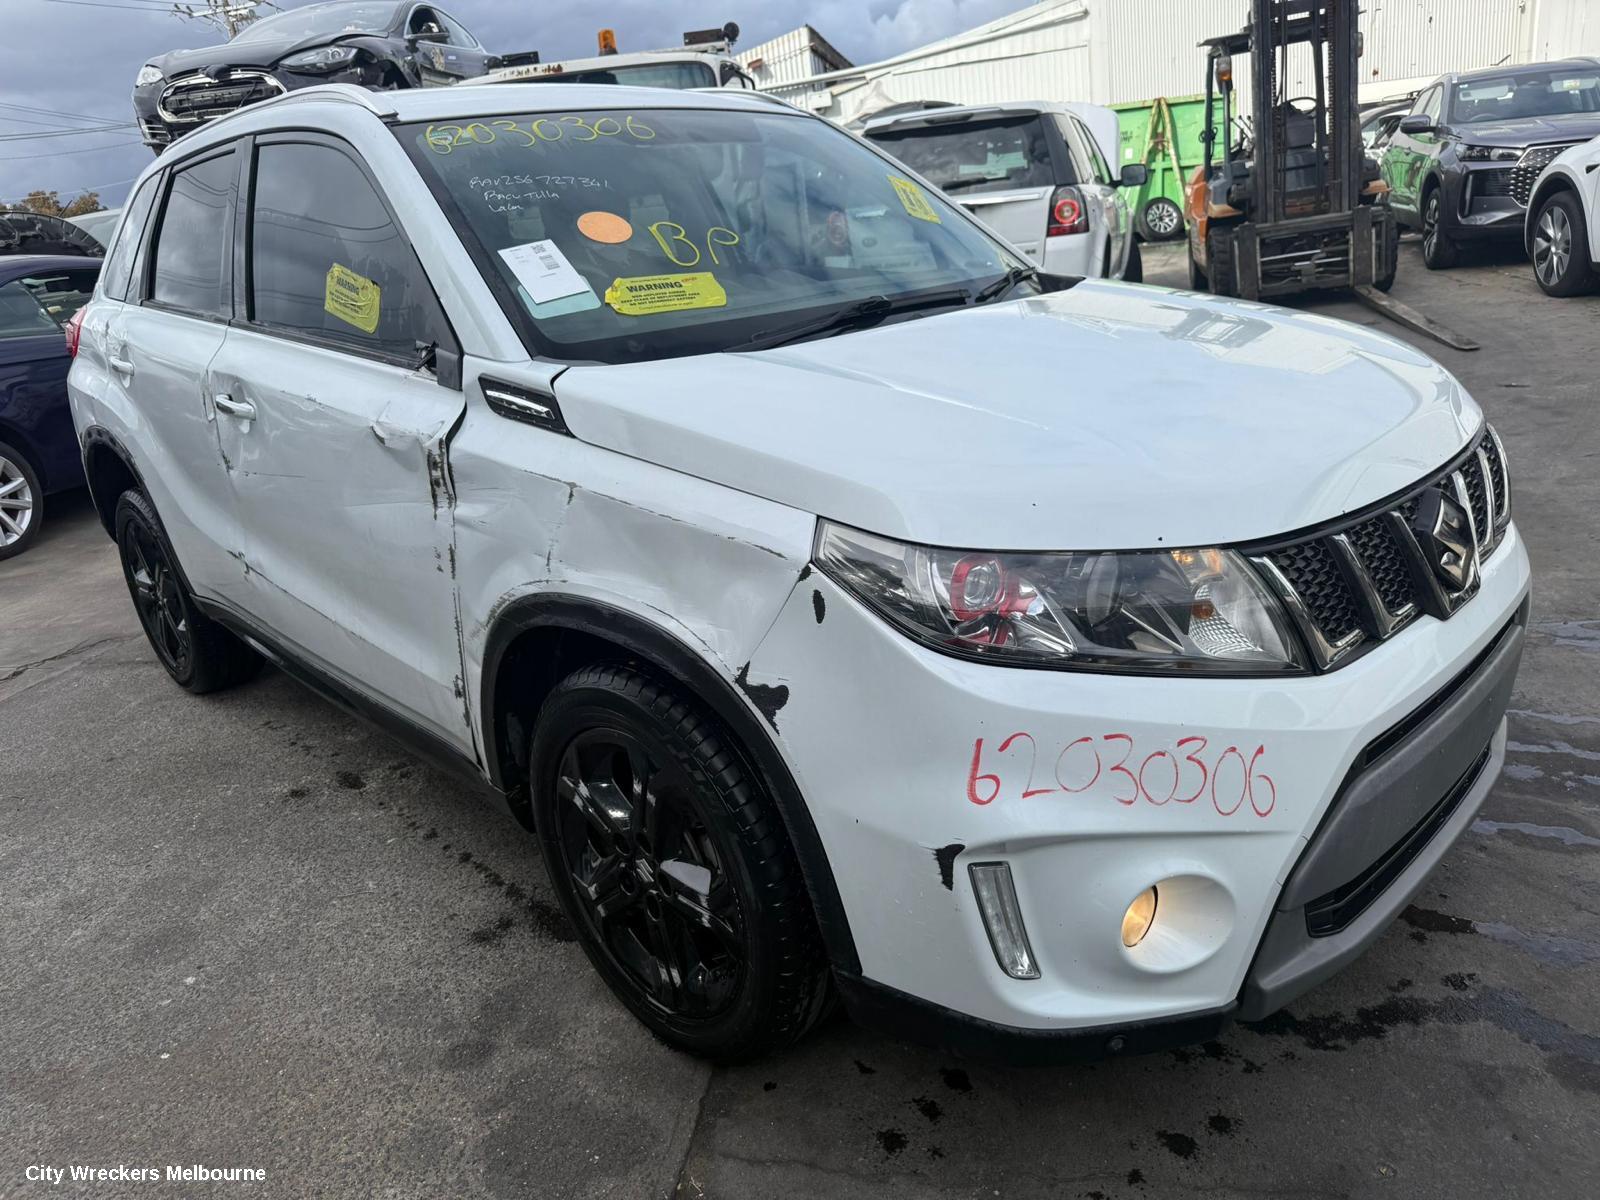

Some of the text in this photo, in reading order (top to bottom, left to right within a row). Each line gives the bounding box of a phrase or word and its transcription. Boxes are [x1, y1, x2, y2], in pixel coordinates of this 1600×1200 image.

[426, 115, 655, 154] 62030306
[626, 281, 683, 293] WARNING
[967, 732, 1275, 817] 62030306
